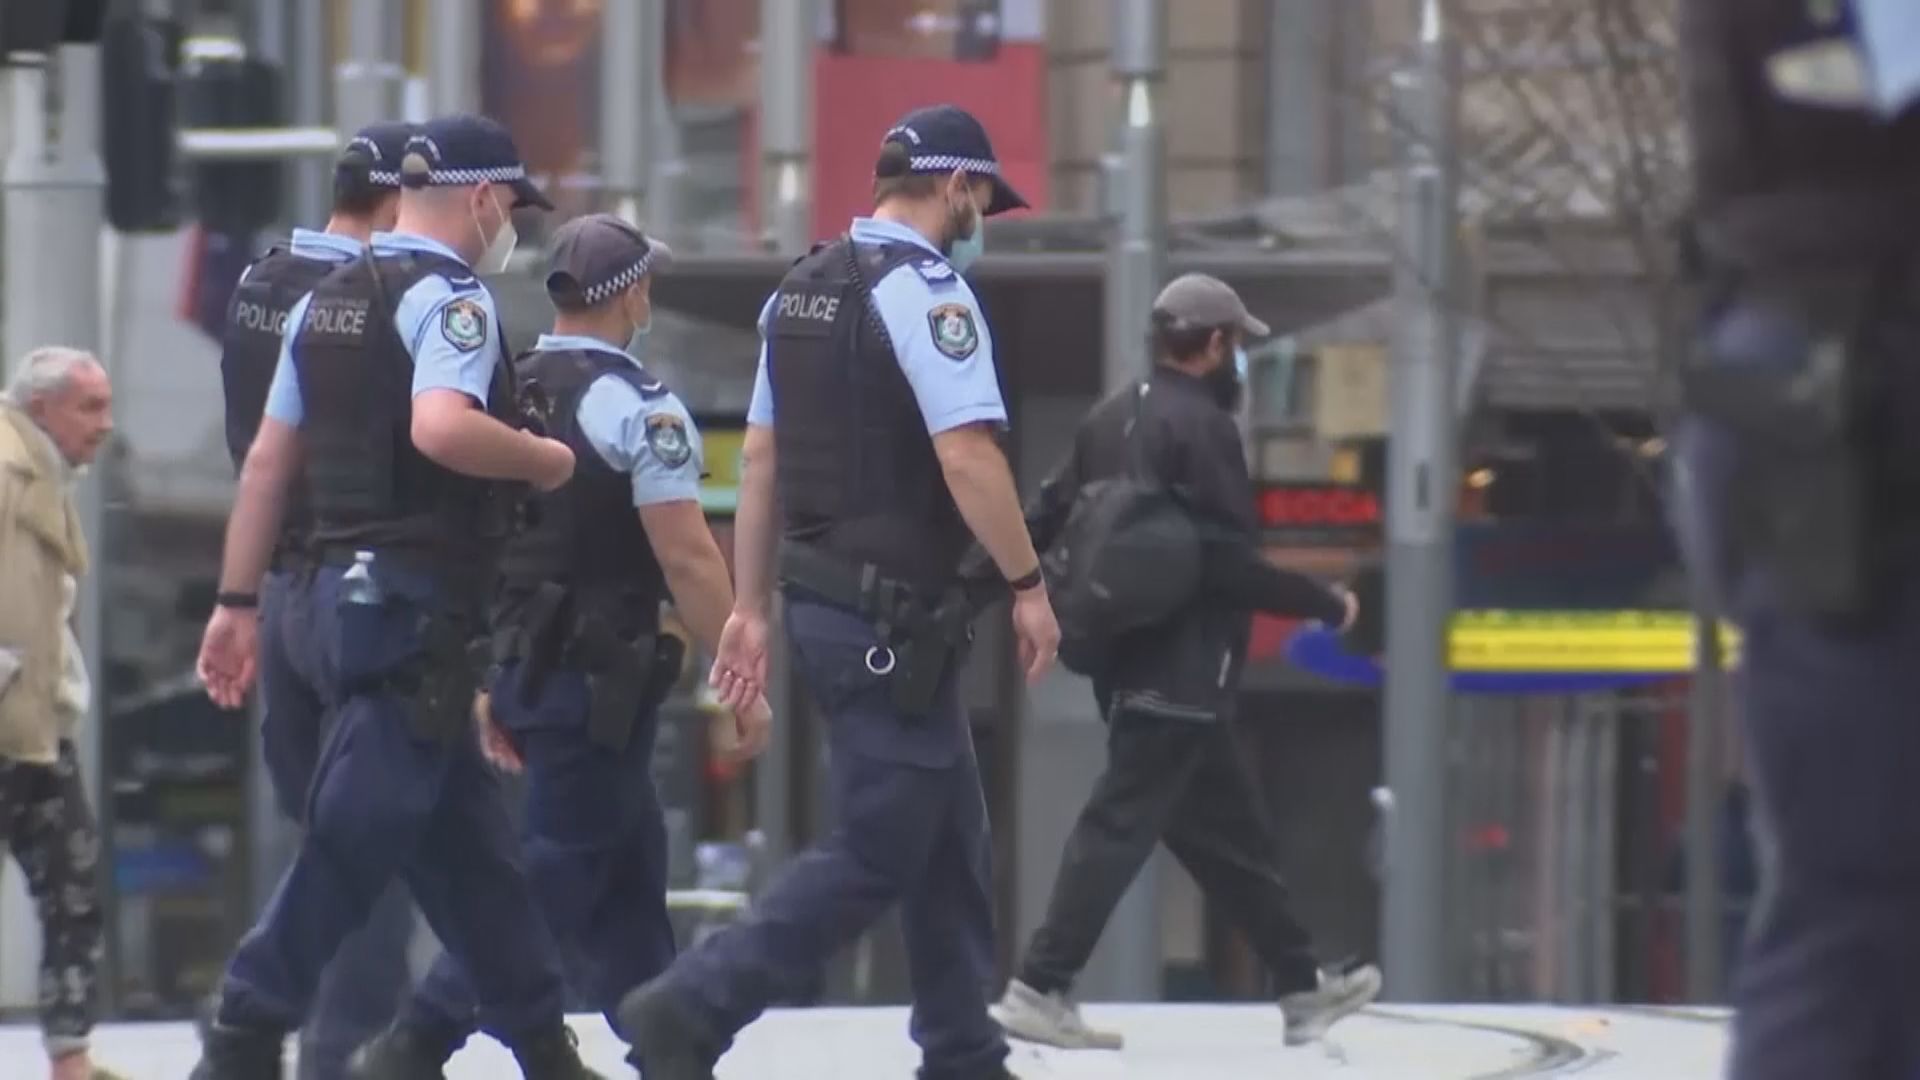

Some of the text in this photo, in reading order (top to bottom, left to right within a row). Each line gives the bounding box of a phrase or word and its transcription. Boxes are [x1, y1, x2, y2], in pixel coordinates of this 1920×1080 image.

[237, 300, 289, 335] POLIC
[304, 307, 368, 335] POLICE
[778, 293, 840, 322] POLICE
